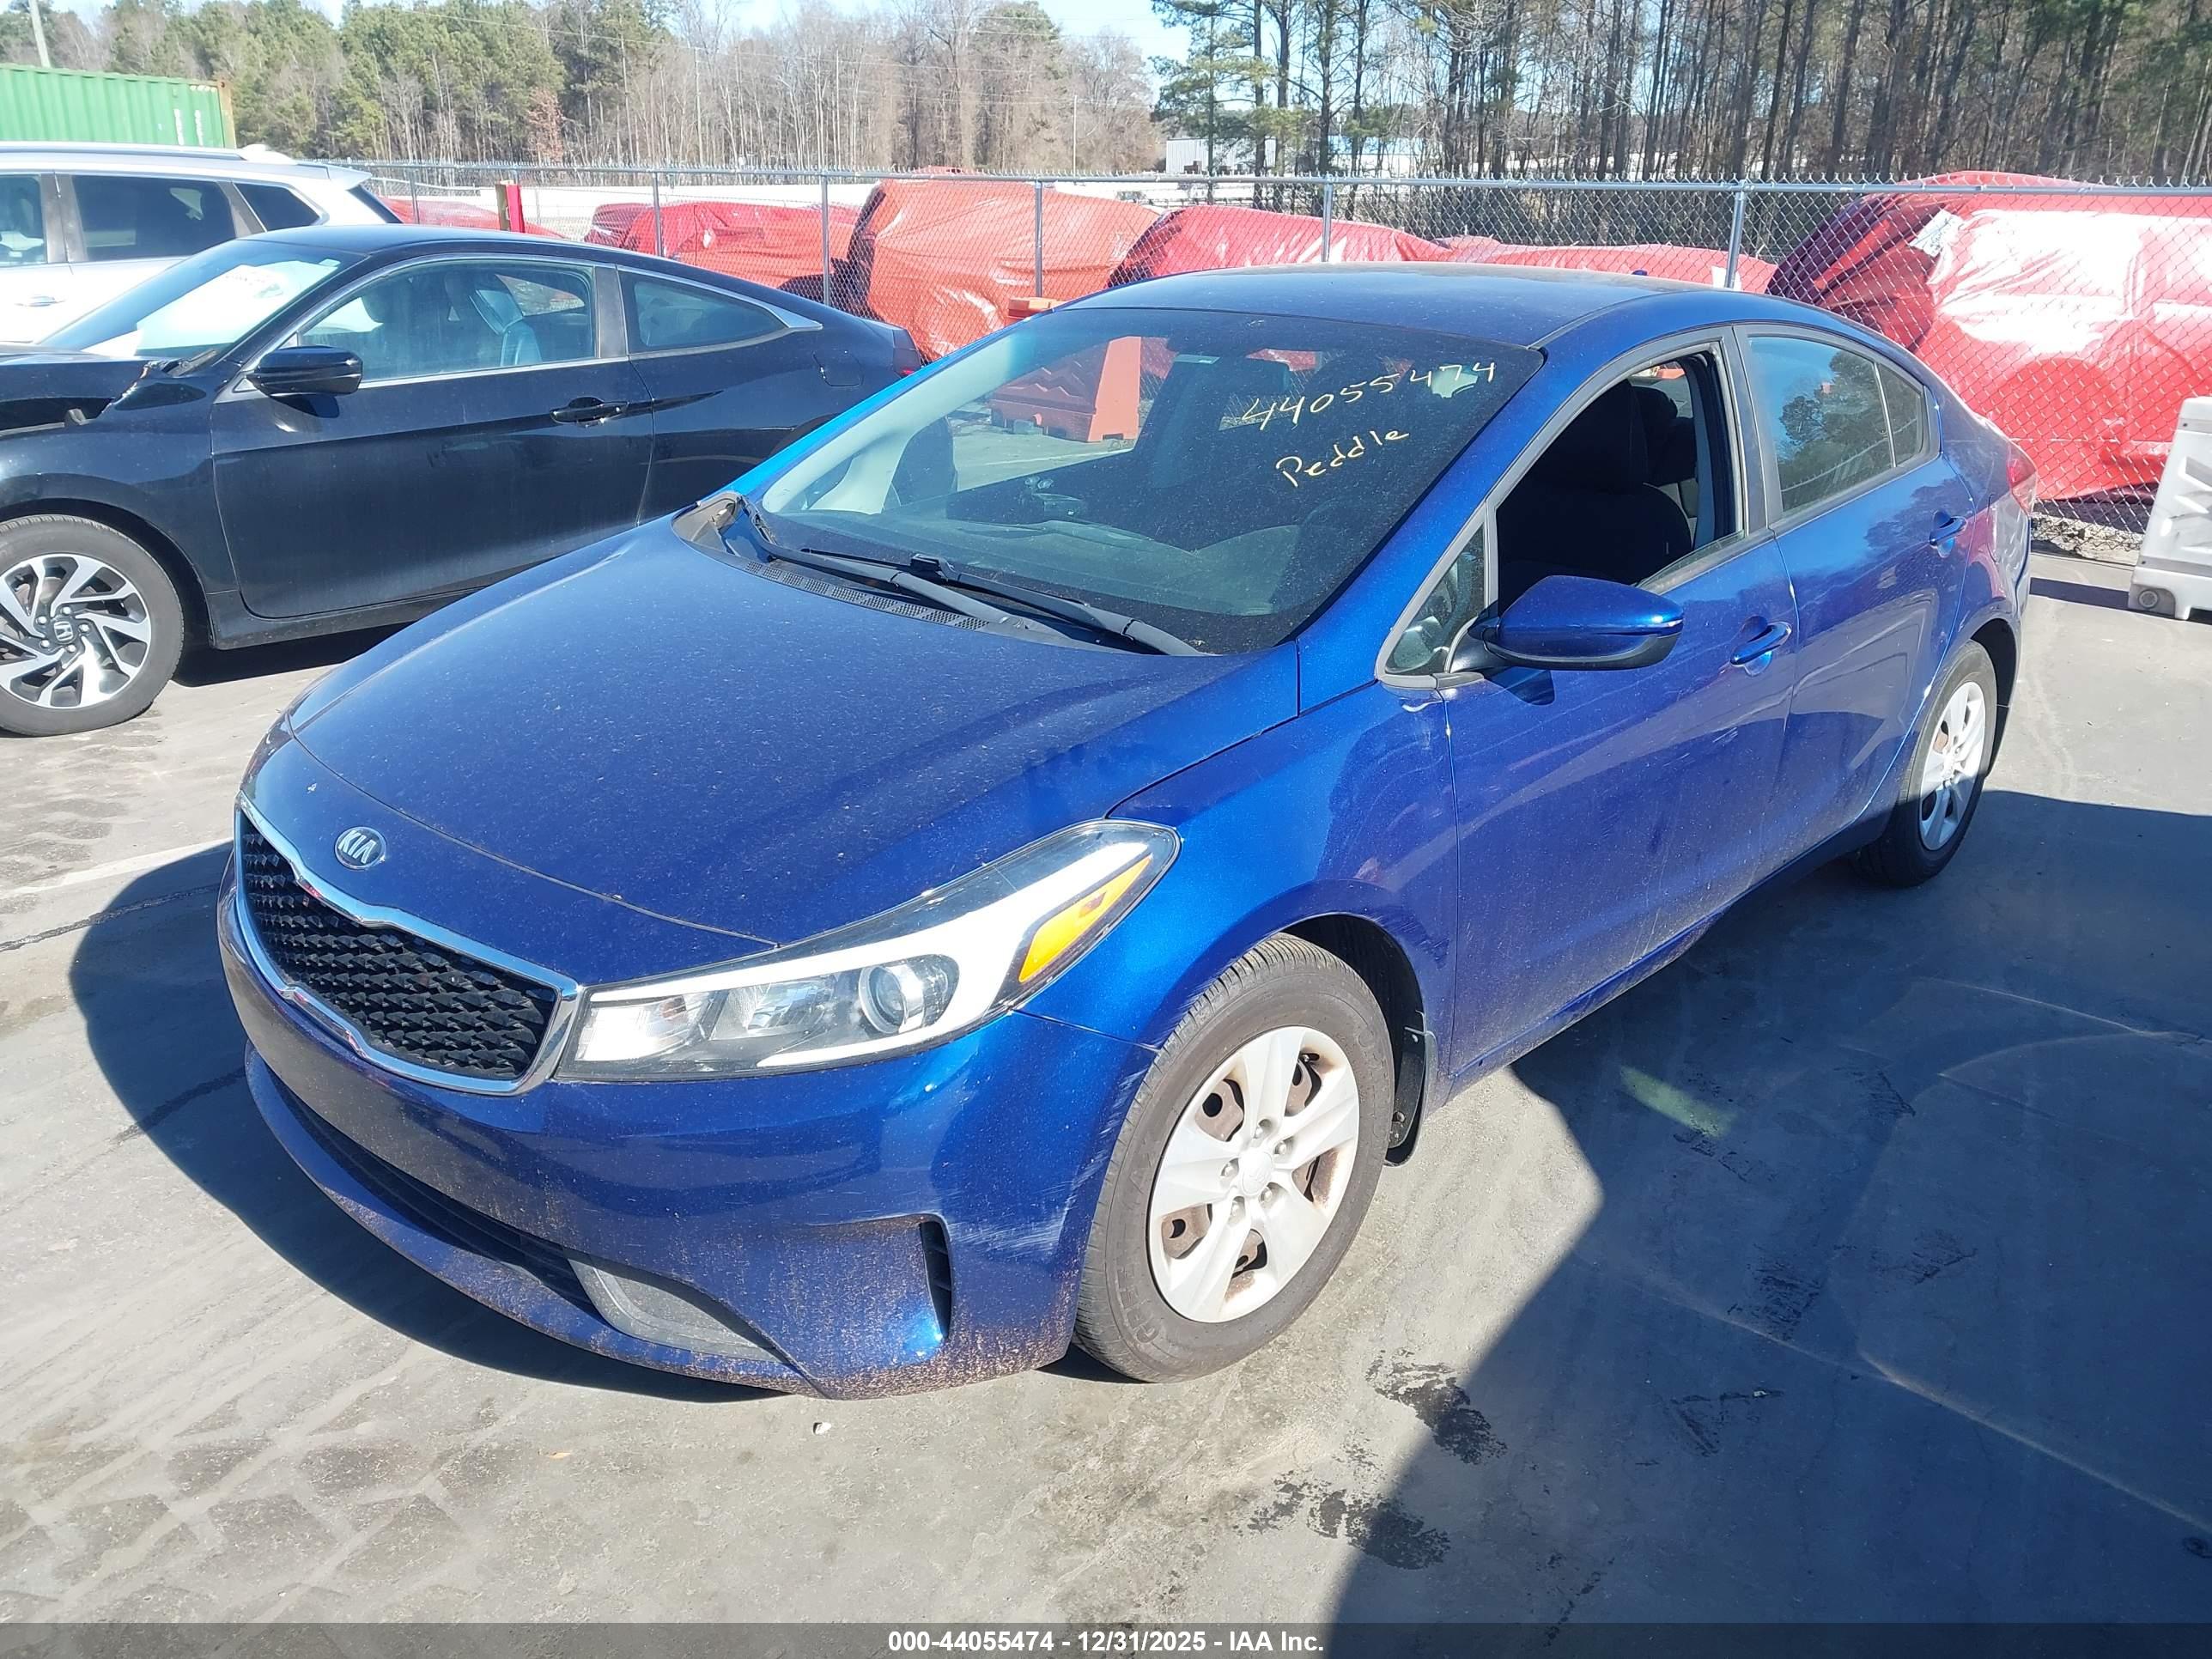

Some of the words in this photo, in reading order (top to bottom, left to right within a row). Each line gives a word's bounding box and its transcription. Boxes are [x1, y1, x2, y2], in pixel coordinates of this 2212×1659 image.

[1242, 362, 1496, 431] 44055474
[1275, 429, 1410, 488] Peddle
[337, 830, 377, 864] KIA
